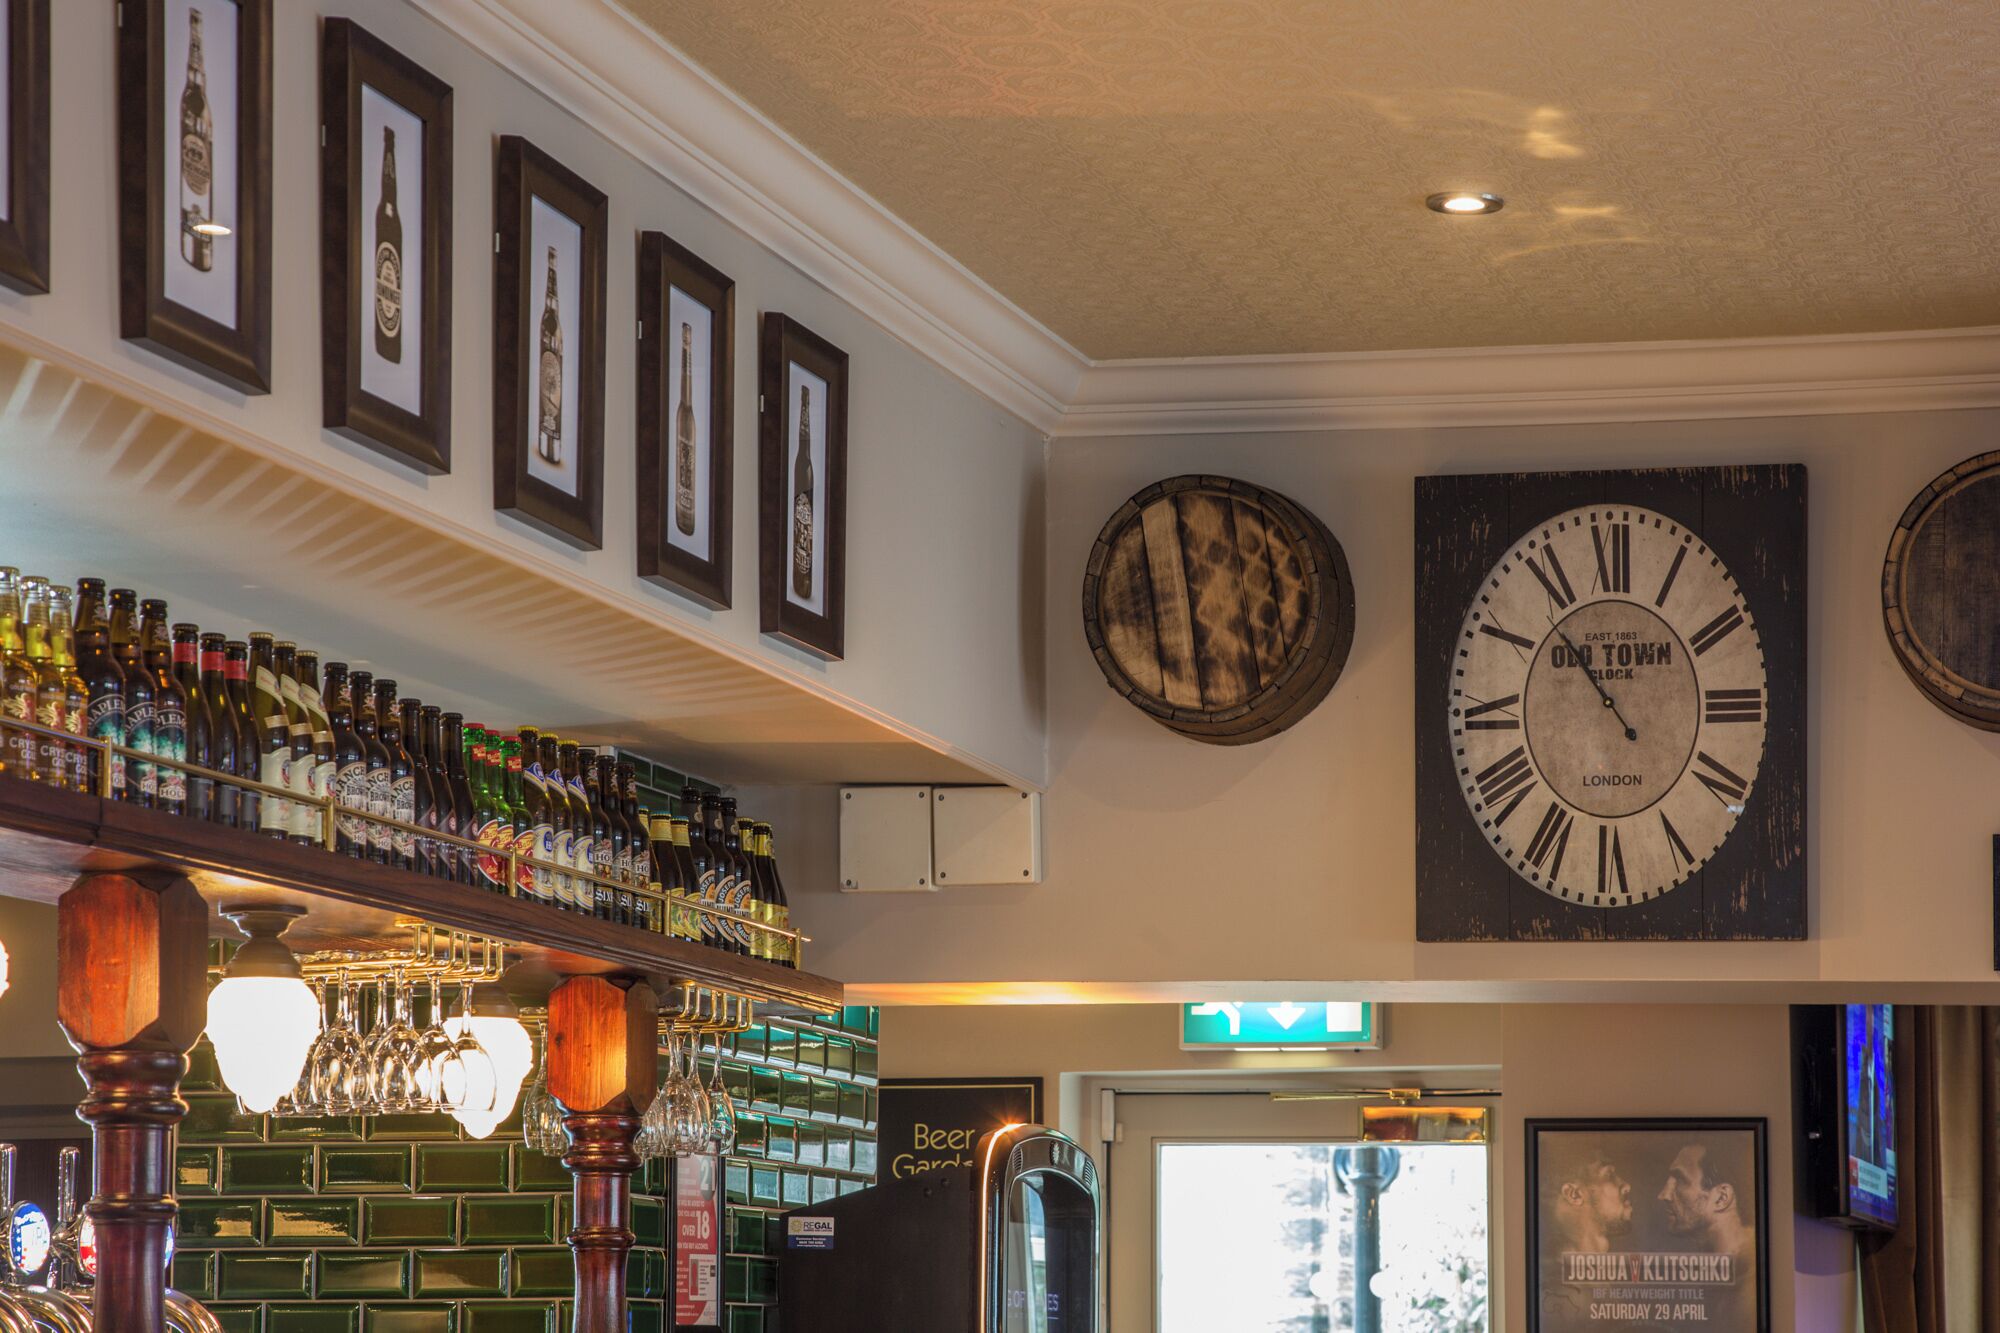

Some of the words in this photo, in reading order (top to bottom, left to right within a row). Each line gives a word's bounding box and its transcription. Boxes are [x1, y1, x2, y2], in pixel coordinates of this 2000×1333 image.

[1585, 633, 1611, 641] EAST
[1551, 644, 1592, 668] OLD
[1602, 642, 1672, 667] TOWN
[1590, 668, 1634, 680] CLOCK
[1582, 774, 1642, 787] LONDON
[914, 1124, 976, 1150] Beer
[696, 1210, 710, 1240] 18
[1568, 1255, 1628, 1280] JOSHUA
[1644, 1256, 1730, 1282] KLITSCHKO
[1592, 1288, 1606, 1299] IBF
[1610, 1288, 1675, 1300] HEAVYWEIGHT
[1678, 1289, 1704, 1300] TITLE
[1590, 1304, 1650, 1320] SATURDAY
[1654, 1304, 1670, 1320] 29
[1673, 1304, 1708, 1320] APRIL
